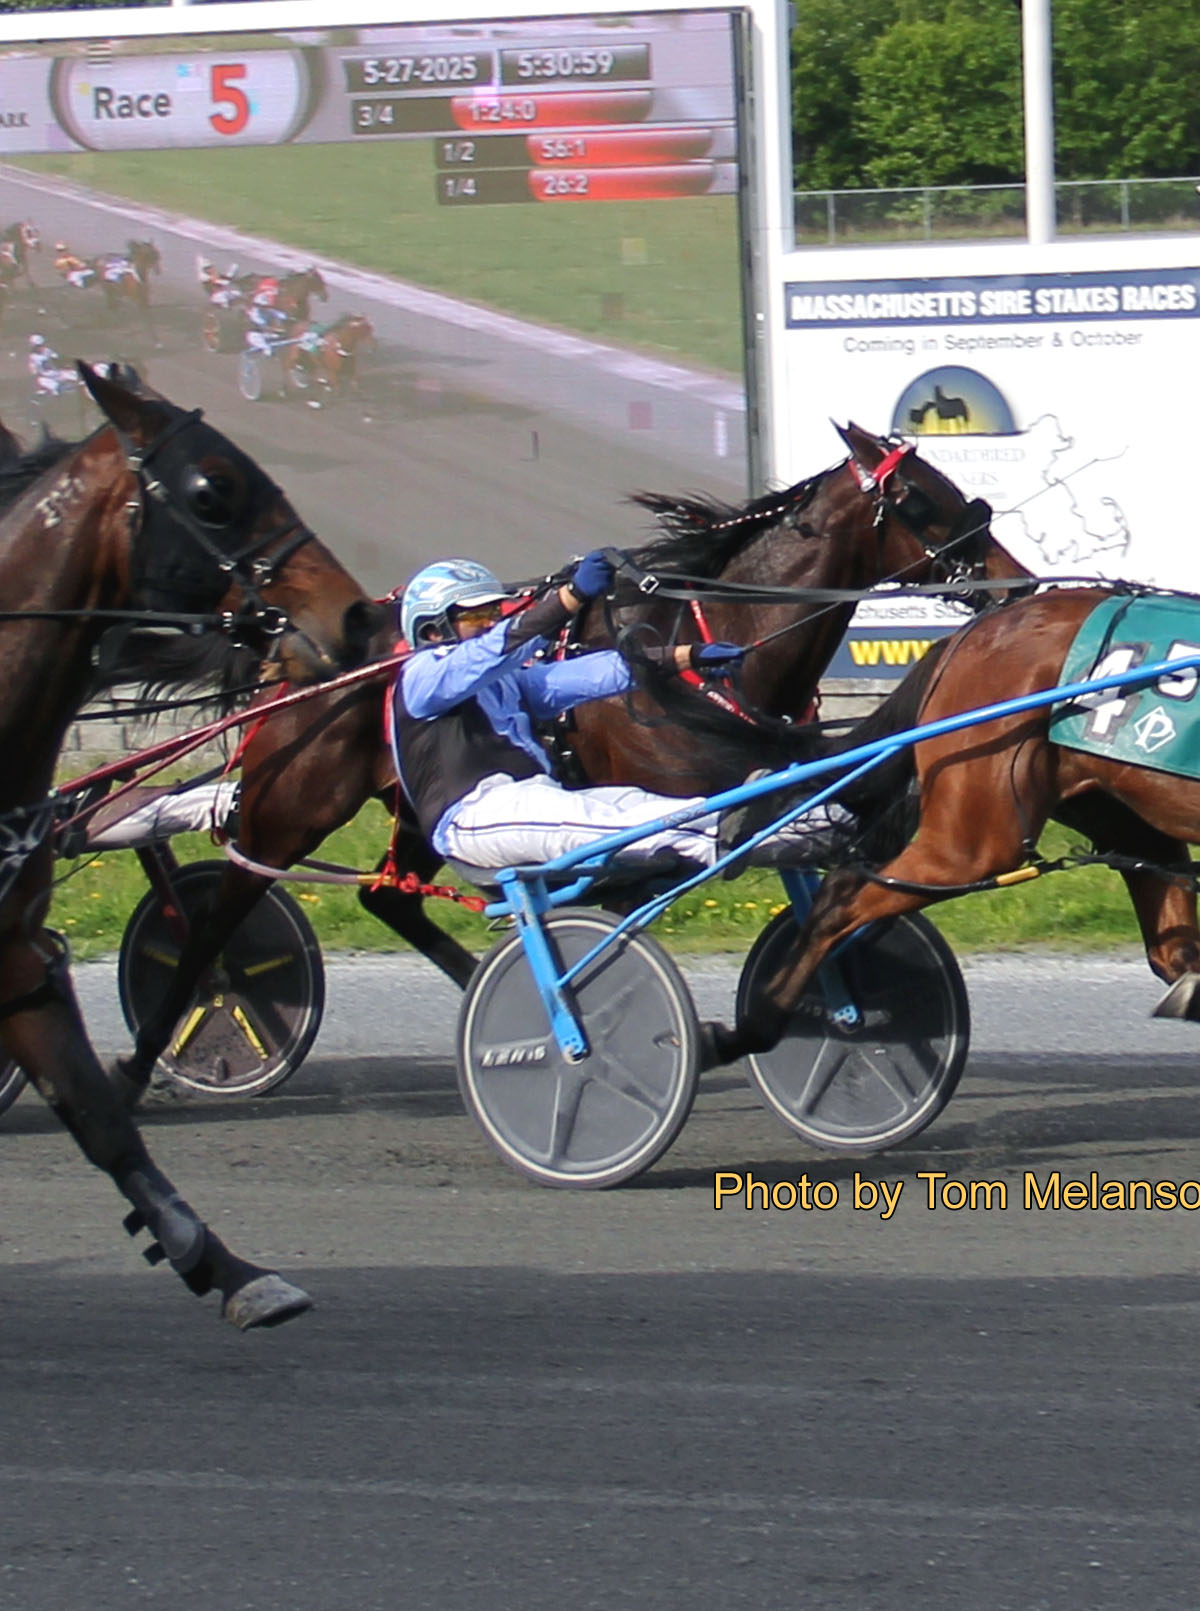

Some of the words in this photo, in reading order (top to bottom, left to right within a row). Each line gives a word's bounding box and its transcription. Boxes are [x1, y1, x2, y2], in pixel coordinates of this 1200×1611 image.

[364, 56, 477, 84] 5-27-2025
[518, 51, 614, 78] 5:30:59
[95, 86, 171, 120] Race
[208, 64, 250, 135] 5
[358, 105, 394, 127] 3/4
[443, 141, 476, 163] 1/2
[540, 139, 587, 160] 56:1
[446, 178, 477, 197] 1/4
[543, 175, 589, 195] 26:2
[790, 291, 978, 322] MASSACHUSETTS
[979, 289, 1034, 317] SIRE
[1034, 286, 1120, 315] STAKES
[1121, 285, 1196, 312] RACES
[843, 335, 915, 355] Coming
[921, 335, 938, 352] in
[944, 333, 1044, 355] September
[1051, 331, 1064, 347] &
[1070, 330, 1144, 348] October
